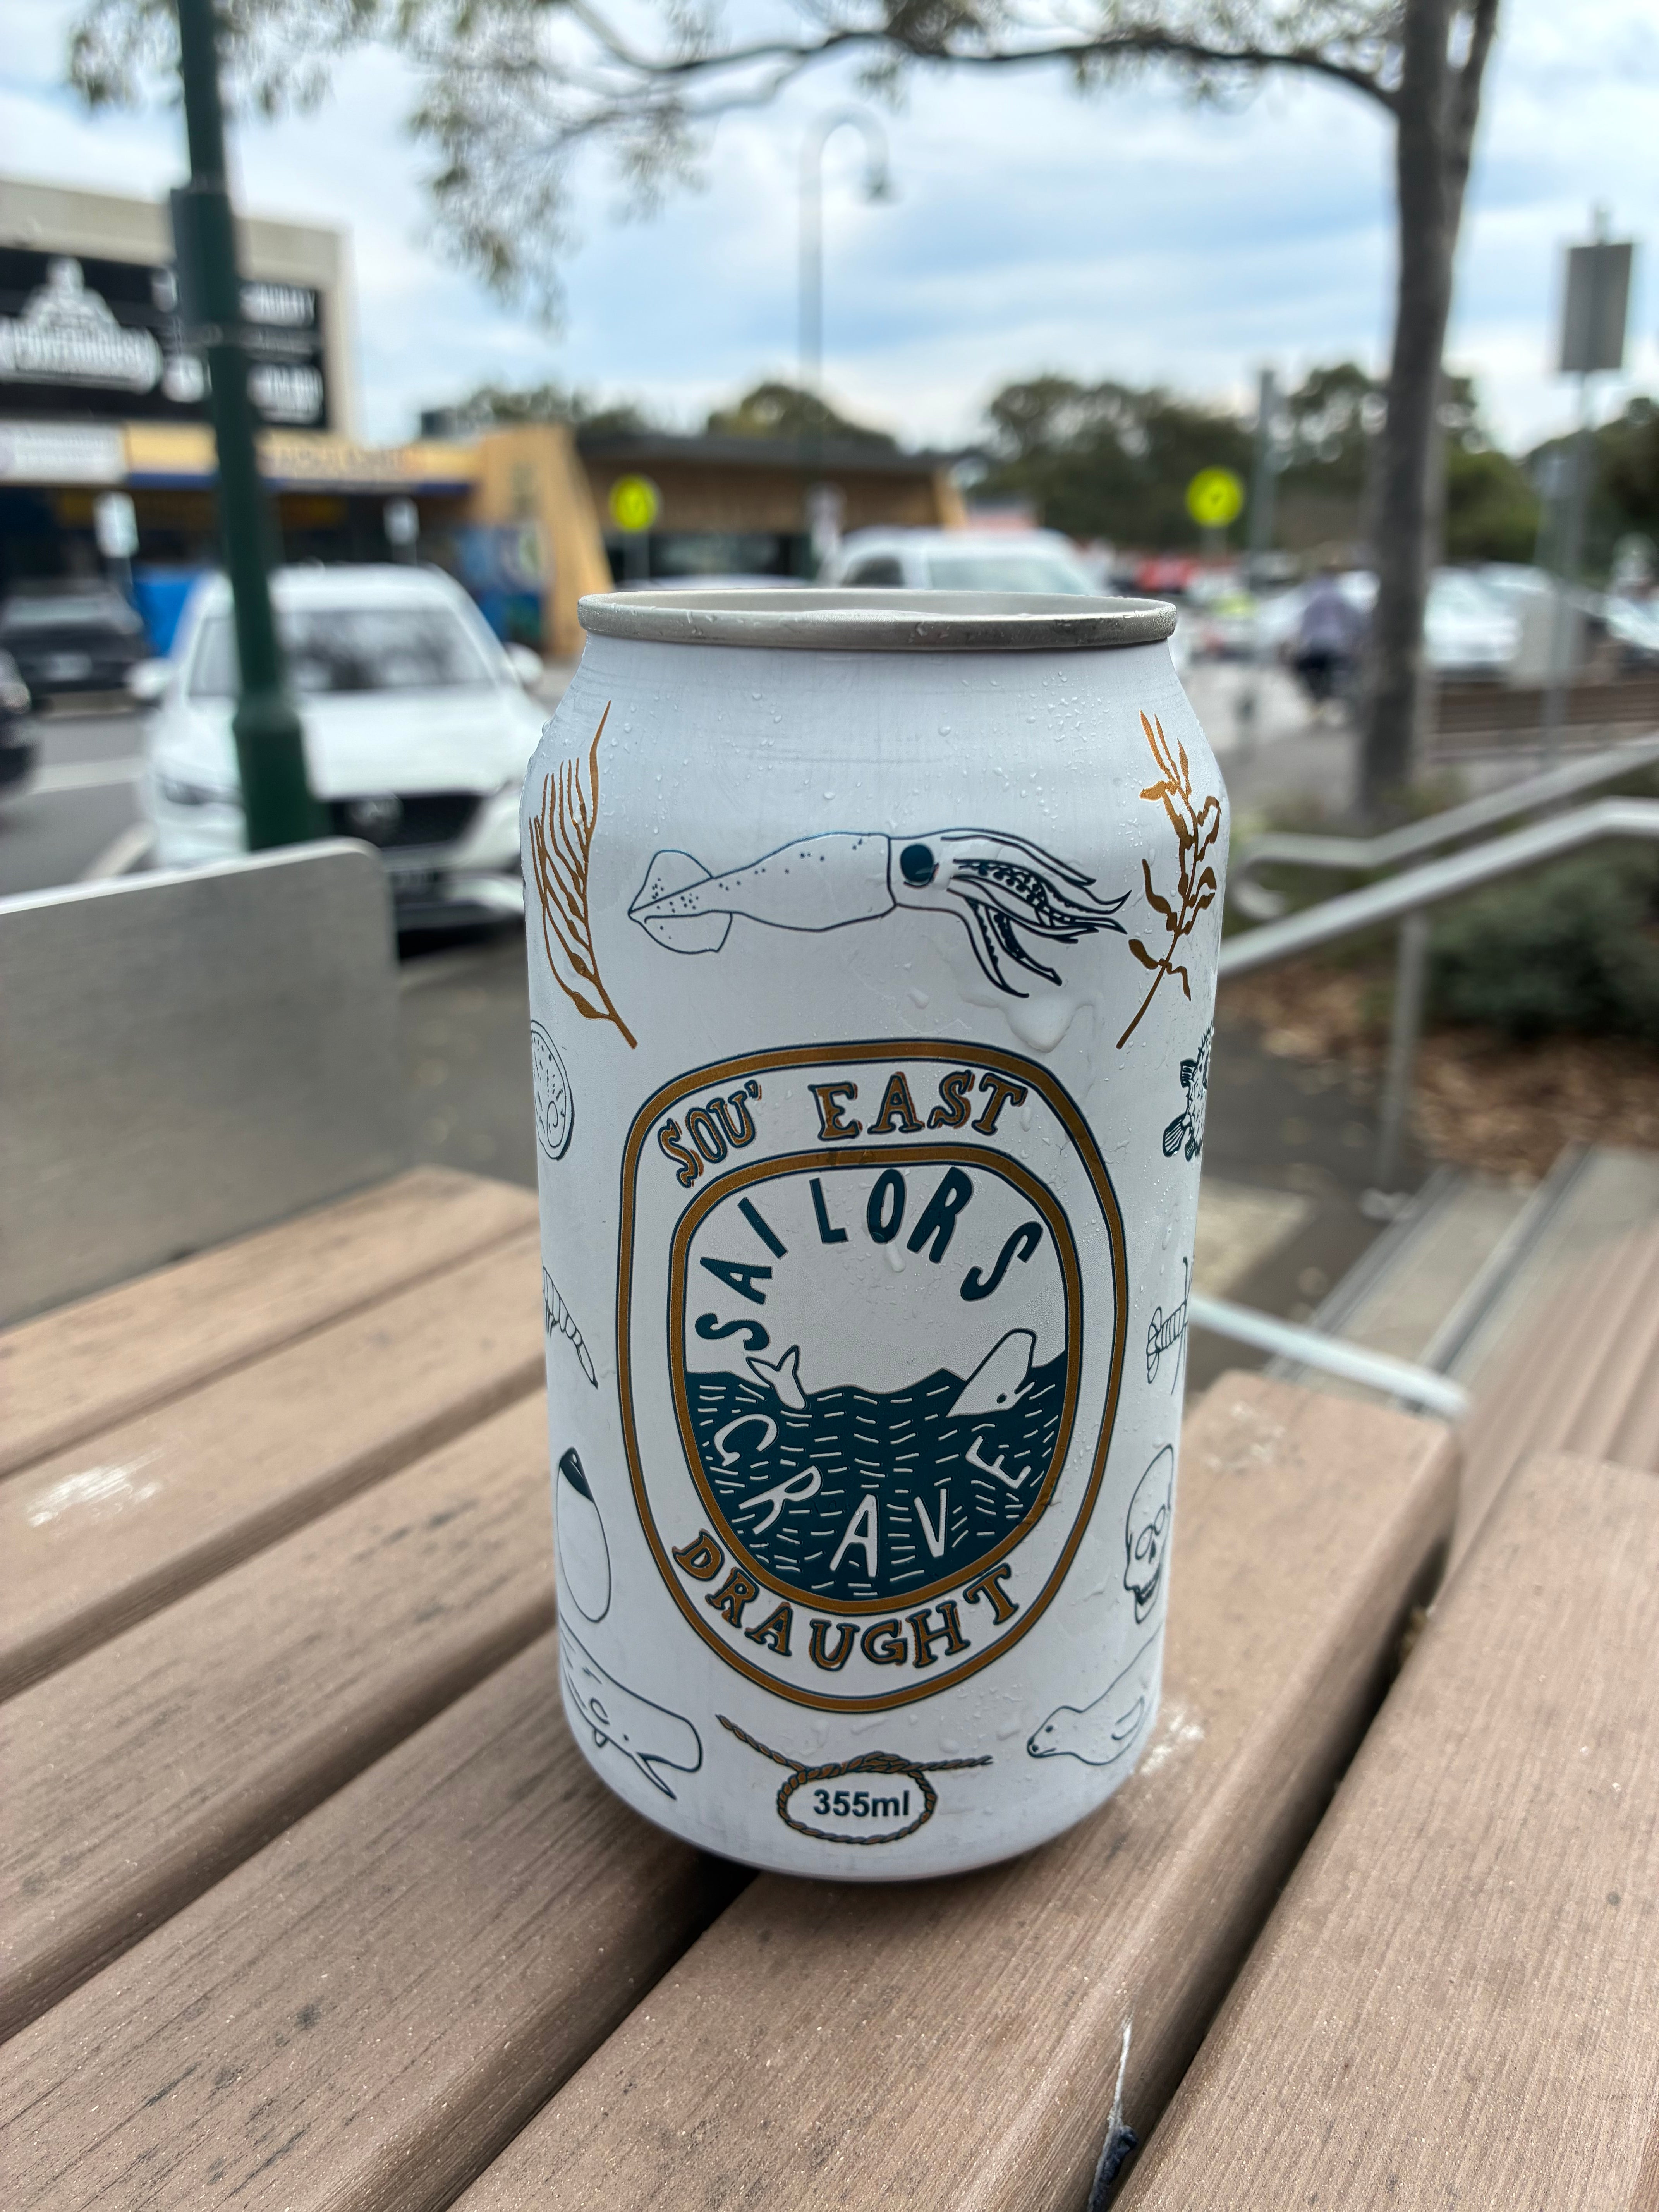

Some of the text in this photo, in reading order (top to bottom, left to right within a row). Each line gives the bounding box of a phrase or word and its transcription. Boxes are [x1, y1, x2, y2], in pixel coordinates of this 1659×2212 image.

[658, 1071, 1027, 1187] SOU' EAST
[695, 1167, 1043, 1351] SAILORS
[714, 1414, 1031, 1577] CRAVE
[673, 1529, 1020, 1671] DRAUGHT
[813, 1789, 910, 1818] 355ml
